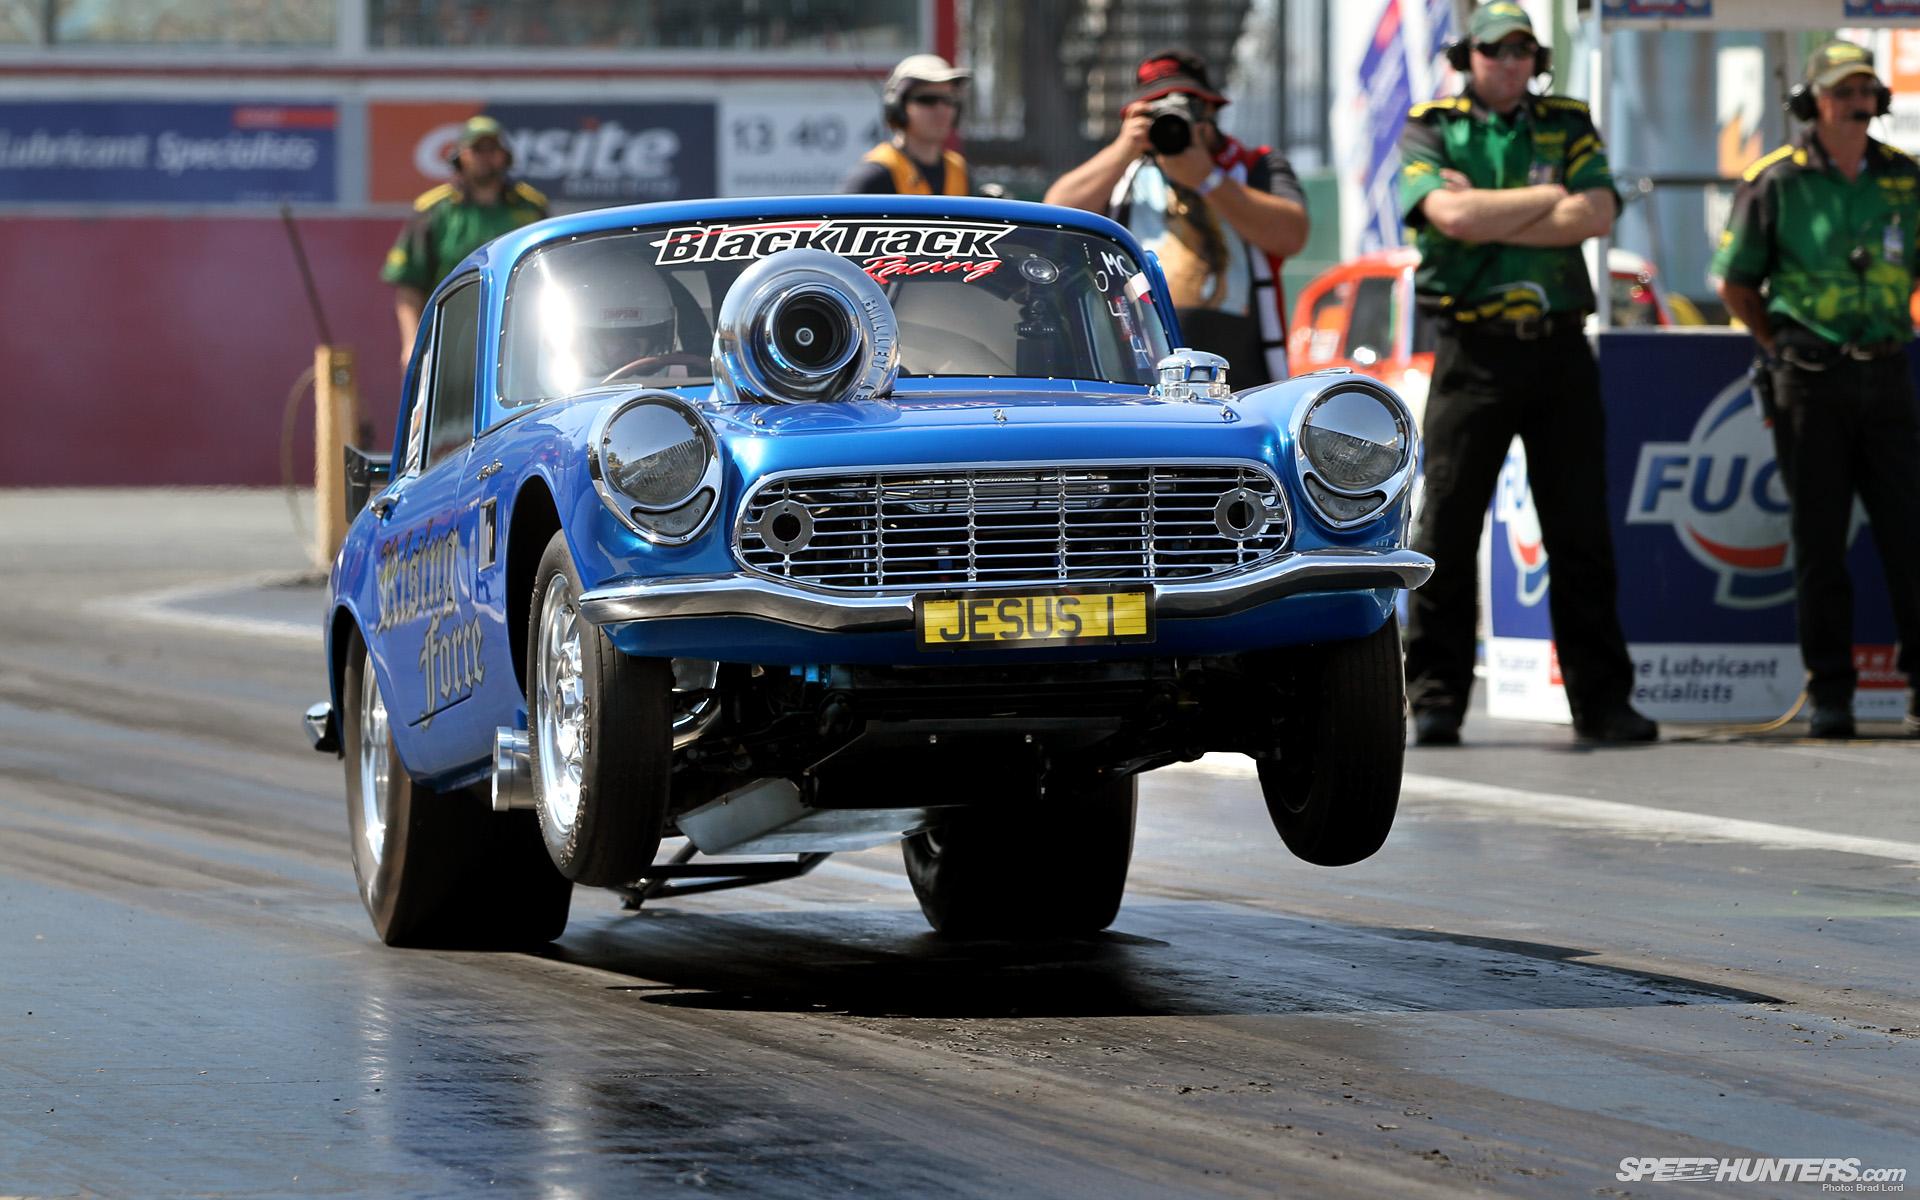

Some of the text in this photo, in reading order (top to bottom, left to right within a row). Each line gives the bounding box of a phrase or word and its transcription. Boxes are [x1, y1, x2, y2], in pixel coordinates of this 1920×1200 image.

[156, 131, 316, 176] Specialists
[863, 254, 1002, 284] Racing
[940, 597, 1082, 641] JESUS
[420, 613, 485, 730] Force
[1659, 657, 1778, 679] Lubricant
[1634, 681, 1734, 703] ecialists
